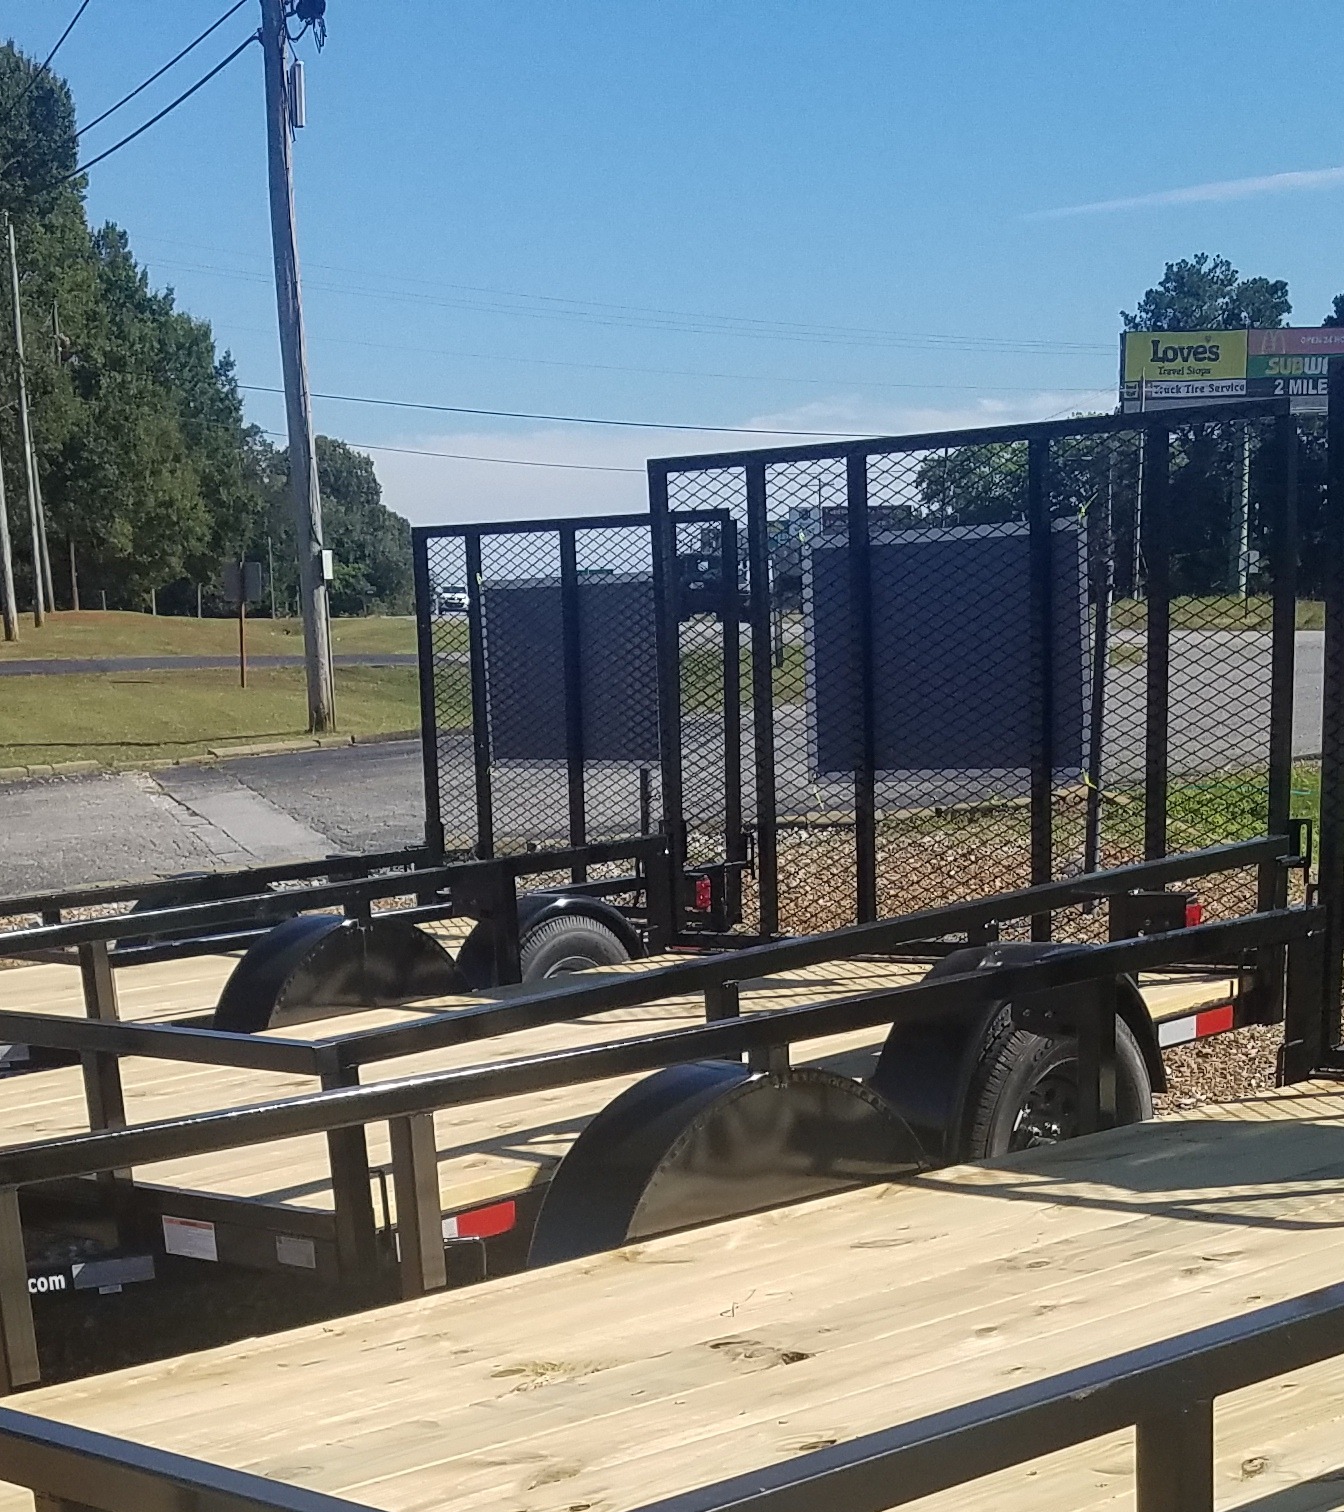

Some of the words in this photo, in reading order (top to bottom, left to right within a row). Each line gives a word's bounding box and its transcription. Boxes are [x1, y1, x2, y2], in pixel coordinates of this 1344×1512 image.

[1265, 356, 1328, 375] SUBW
[1185, 383, 1205, 394] Tire
[1208, 382, 1245, 393] Service
[1274, 379, 1284, 395] 2
[1288, 379, 1328, 395] MILE
